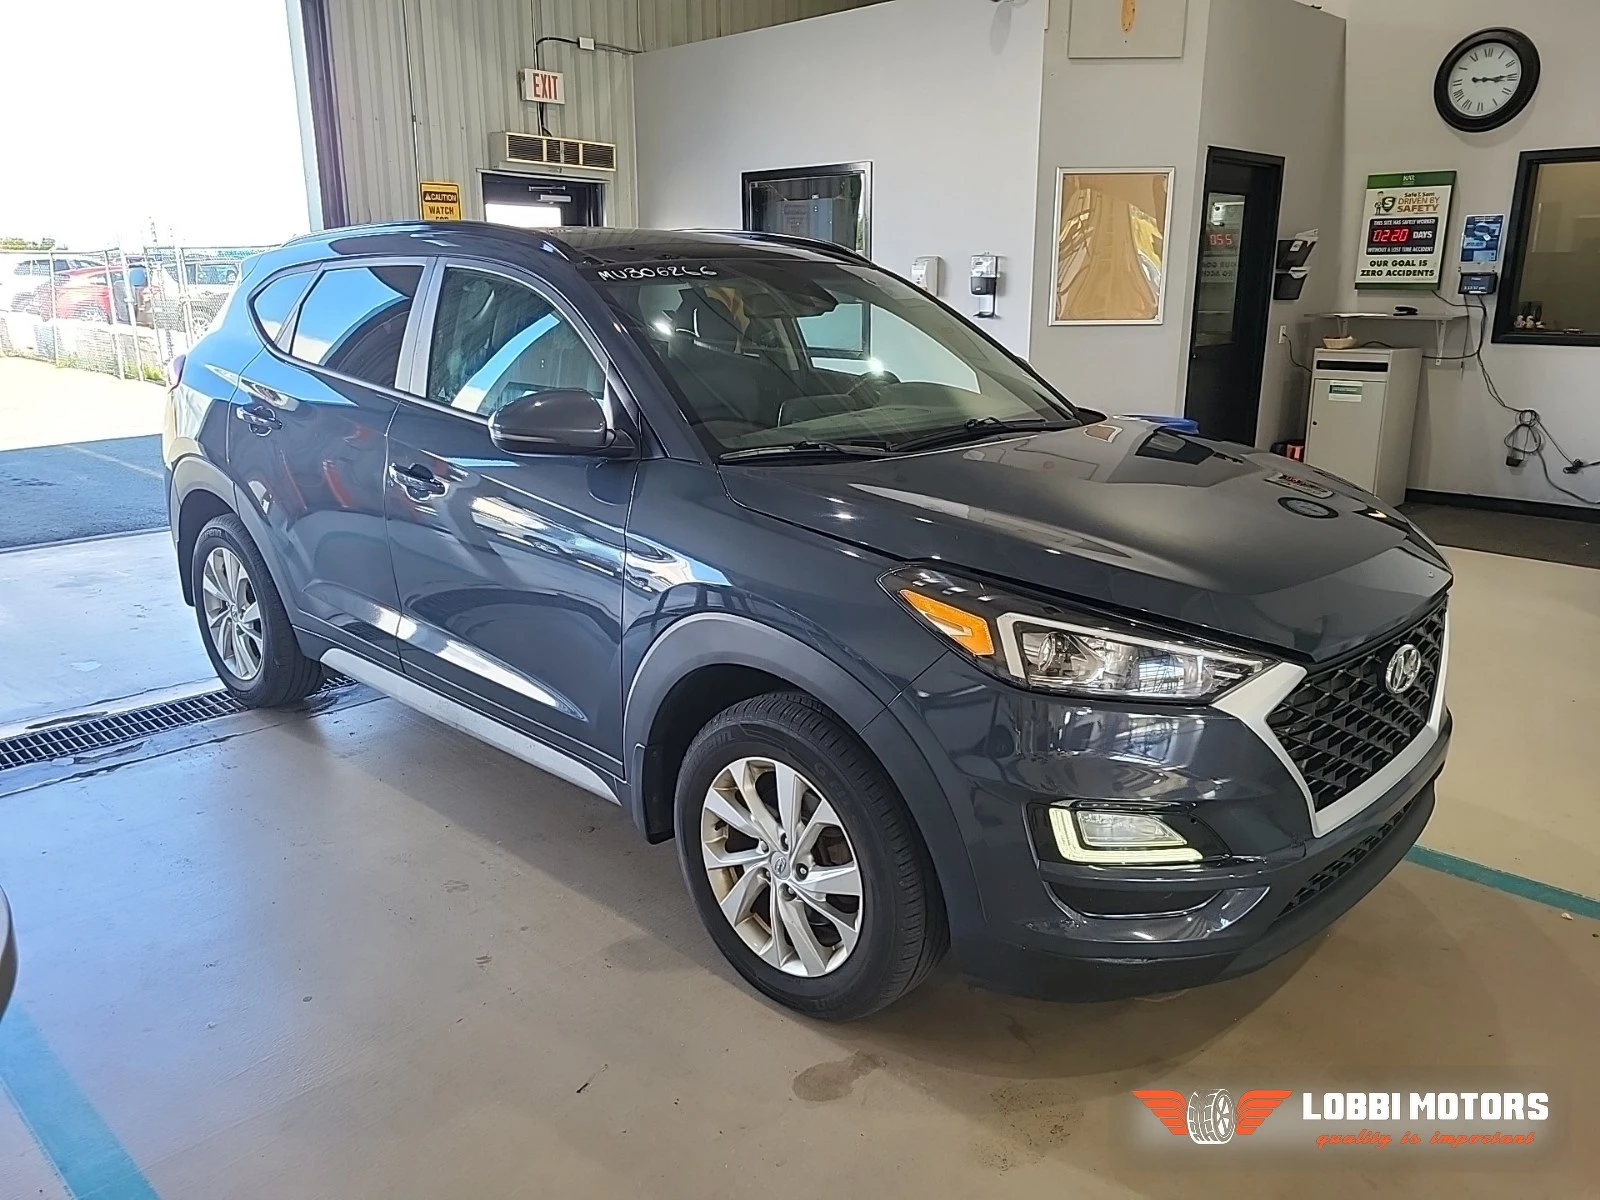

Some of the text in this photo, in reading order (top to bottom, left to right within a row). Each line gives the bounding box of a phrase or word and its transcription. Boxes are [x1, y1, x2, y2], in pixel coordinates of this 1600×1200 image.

[532, 72, 558, 100] EXIT
[430, 193, 457, 202] CAUTION
[1398, 196, 1440, 205] DRIVEN BY
[429, 206, 455, 215] WATCH
[1397, 204, 1440, 213] SAFETY
[1372, 229, 1409, 242] 0220
[1413, 231, 1433, 239] DAYS
[1385, 269, 1435, 277] ACCIDENTS
